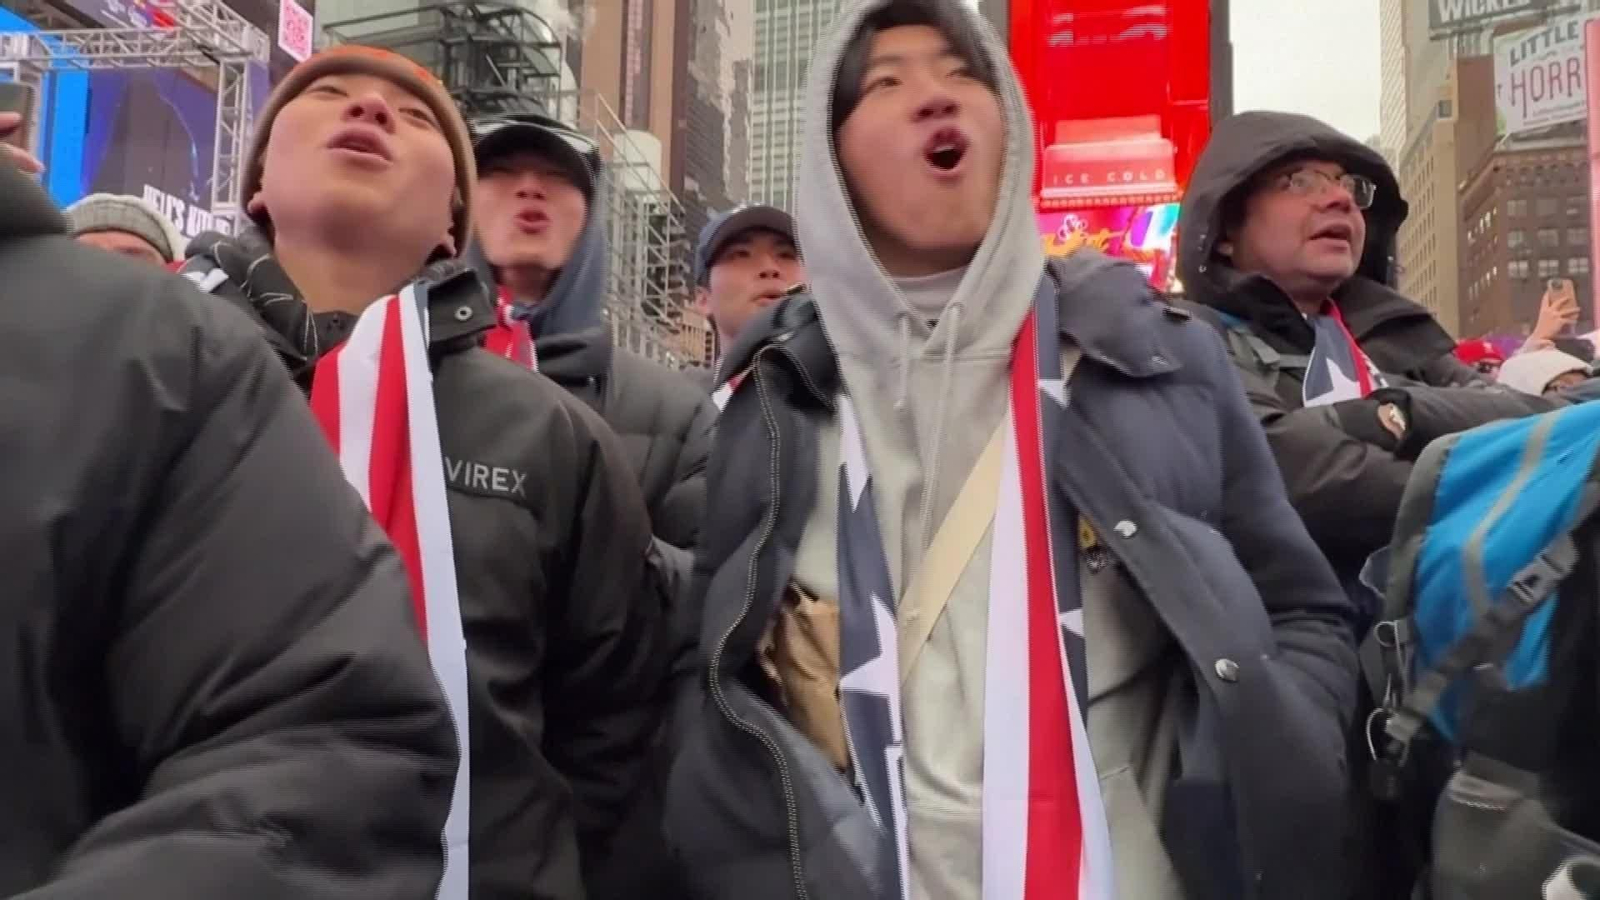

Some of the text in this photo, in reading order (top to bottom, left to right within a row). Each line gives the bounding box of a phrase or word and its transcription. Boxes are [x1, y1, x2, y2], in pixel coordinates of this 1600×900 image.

[1510, 21, 1579, 67] LITTLE
[1053, 168, 1166, 185] ICE COLD
[445, 457, 527, 499] VIREX
